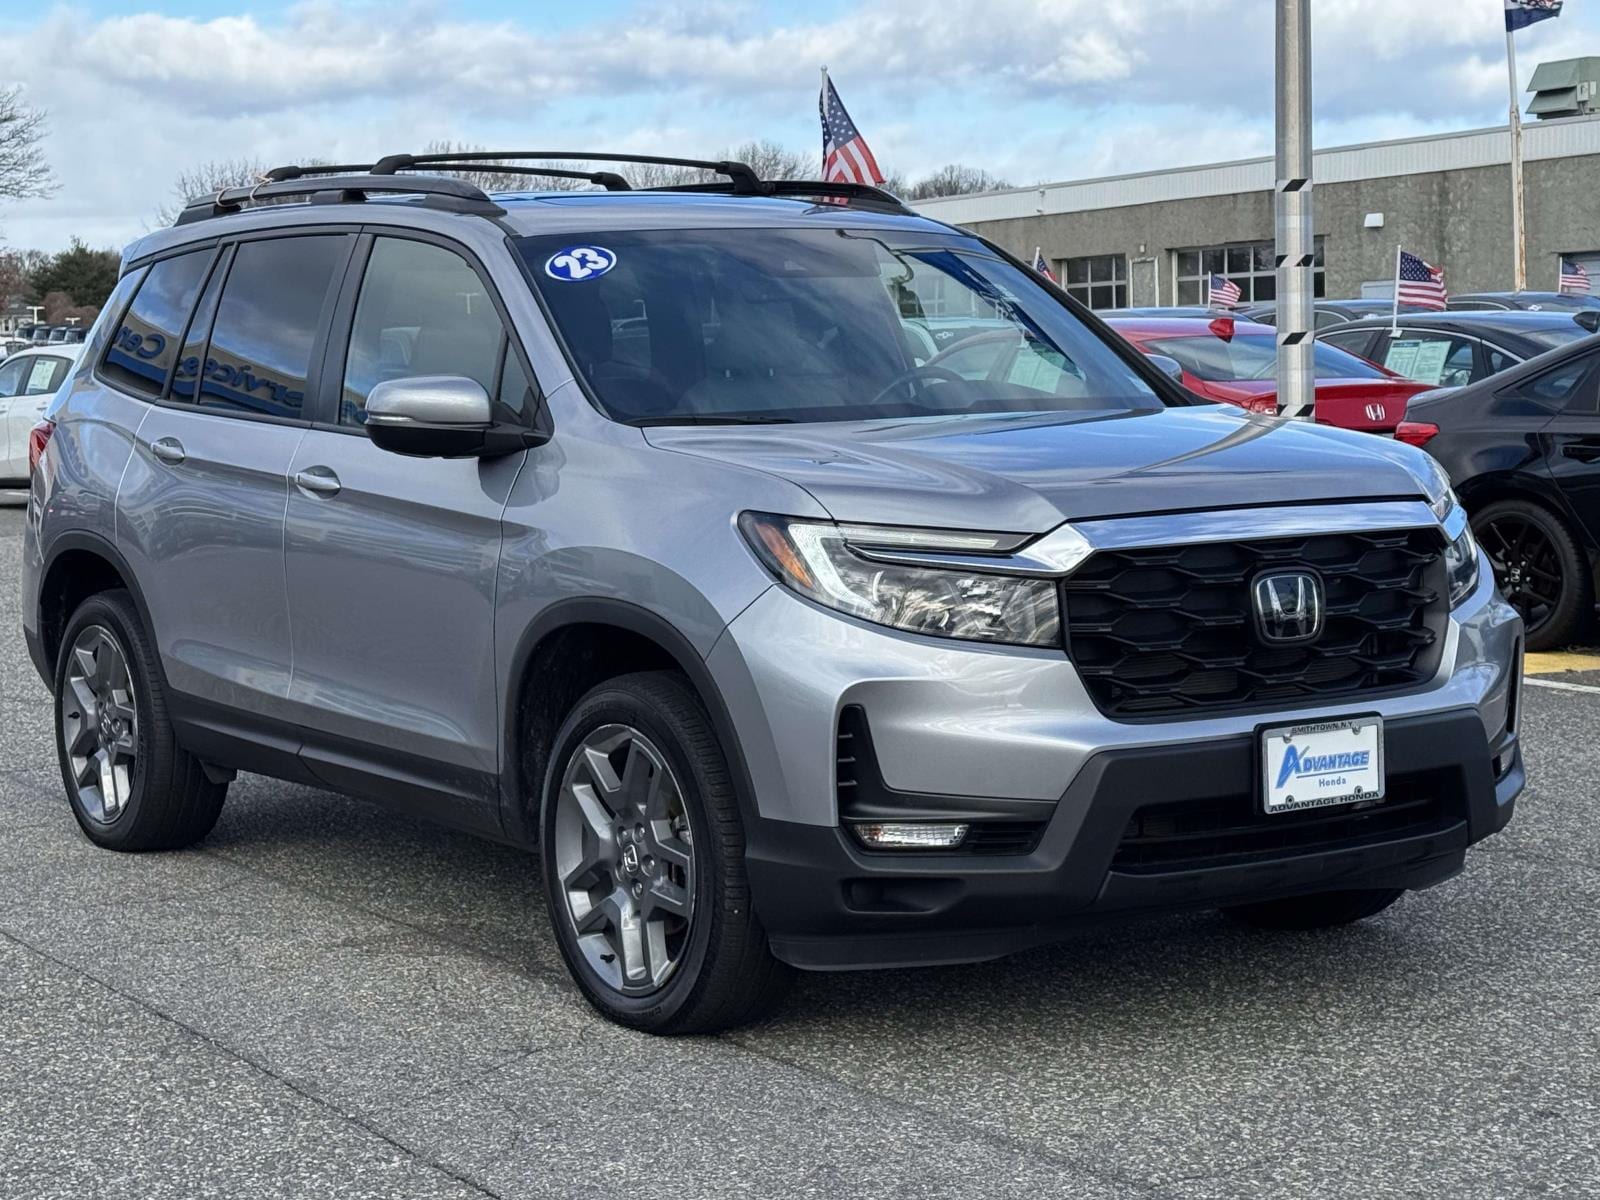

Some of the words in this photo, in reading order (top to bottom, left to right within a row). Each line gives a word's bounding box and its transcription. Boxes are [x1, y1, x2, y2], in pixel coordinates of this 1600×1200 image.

[554, 248, 609, 278] 23
[1275, 744, 1370, 789] ADVANTAGE
[1318, 777, 1347, 787] Honda
[1270, 797, 1337, 813] ADVANTAGE
[1339, 791, 1380, 802] HONDA
